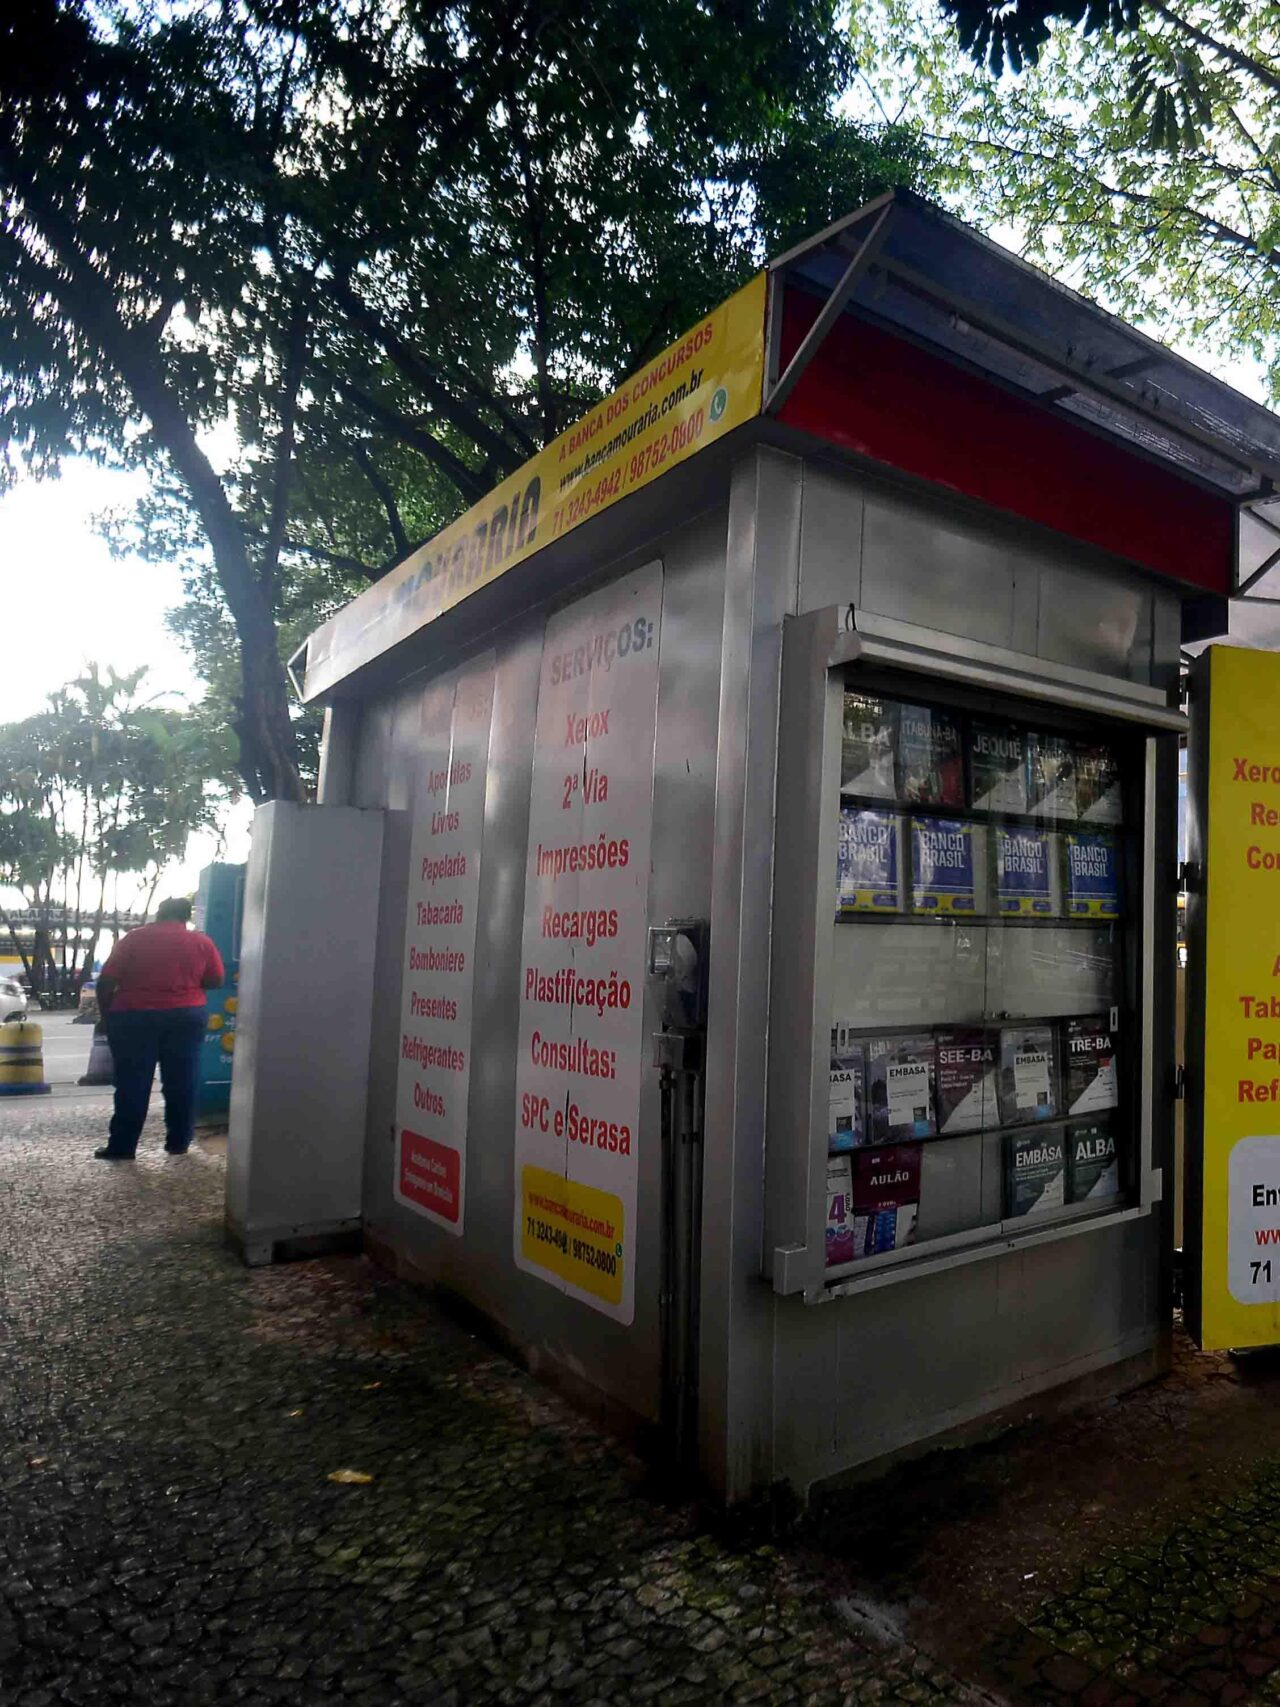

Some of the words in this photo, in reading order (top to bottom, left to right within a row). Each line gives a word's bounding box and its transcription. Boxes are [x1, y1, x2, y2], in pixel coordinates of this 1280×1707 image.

[558, 448, 567, 464] A
[568, 415, 604, 455] BANCA
[606, 391, 629, 427] DOS
[632, 322, 713, 403] CONCURSOS
[629, 407, 705, 484] 98752-0800
[551, 616, 654, 687] SERVIÇOS:
[565, 709, 611, 748] Xerox
[583, 769, 609, 805] Via
[431, 811, 460, 836] Livros
[838, 822, 888, 846] BANCO
[838, 841, 888, 864] BRASIL
[922, 830, 965, 852] BANCO
[1004, 839, 1043, 858] BANCO
[1073, 845, 1108, 863] BANCO
[421, 851, 466, 886] Papelaria
[537, 833, 630, 882] Impressões
[923, 849, 966, 869] BRASIL
[1005, 855, 1043, 874] BRASIL
[1074, 860, 1109, 878] BRASIL
[416, 898, 464, 926] Tabacaria
[542, 903, 619, 947] Recargas
[409, 945, 465, 973] Bomboniere
[410, 990, 457, 1021] Presentes
[525, 967, 632, 1017] Plastificação
[402, 1034, 465, 1072] Refrigerantes
[531, 1030, 616, 1080] Consultas:
[939, 1048, 993, 1064] SEE-BA
[1068, 1036, 1112, 1053] TRE-BA
[889, 1066, 927, 1078] EMBASA
[1015, 1054, 1047, 1066] EMBASA
[414, 1081, 446, 1118] Outros.
[522, 1091, 549, 1133] SPC
[554, 1109, 564, 1137] e
[567, 1103, 631, 1156] Serasa
[1015, 1146, 1063, 1168] EMBASA
[1075, 1137, 1116, 1161] ALBA
[870, 1170, 910, 1186] AULÃO
[828, 1194, 848, 1224] 4
[572, 1238, 617, 1278] 98752-0800
[1250, 1260, 1272, 1285] 71
